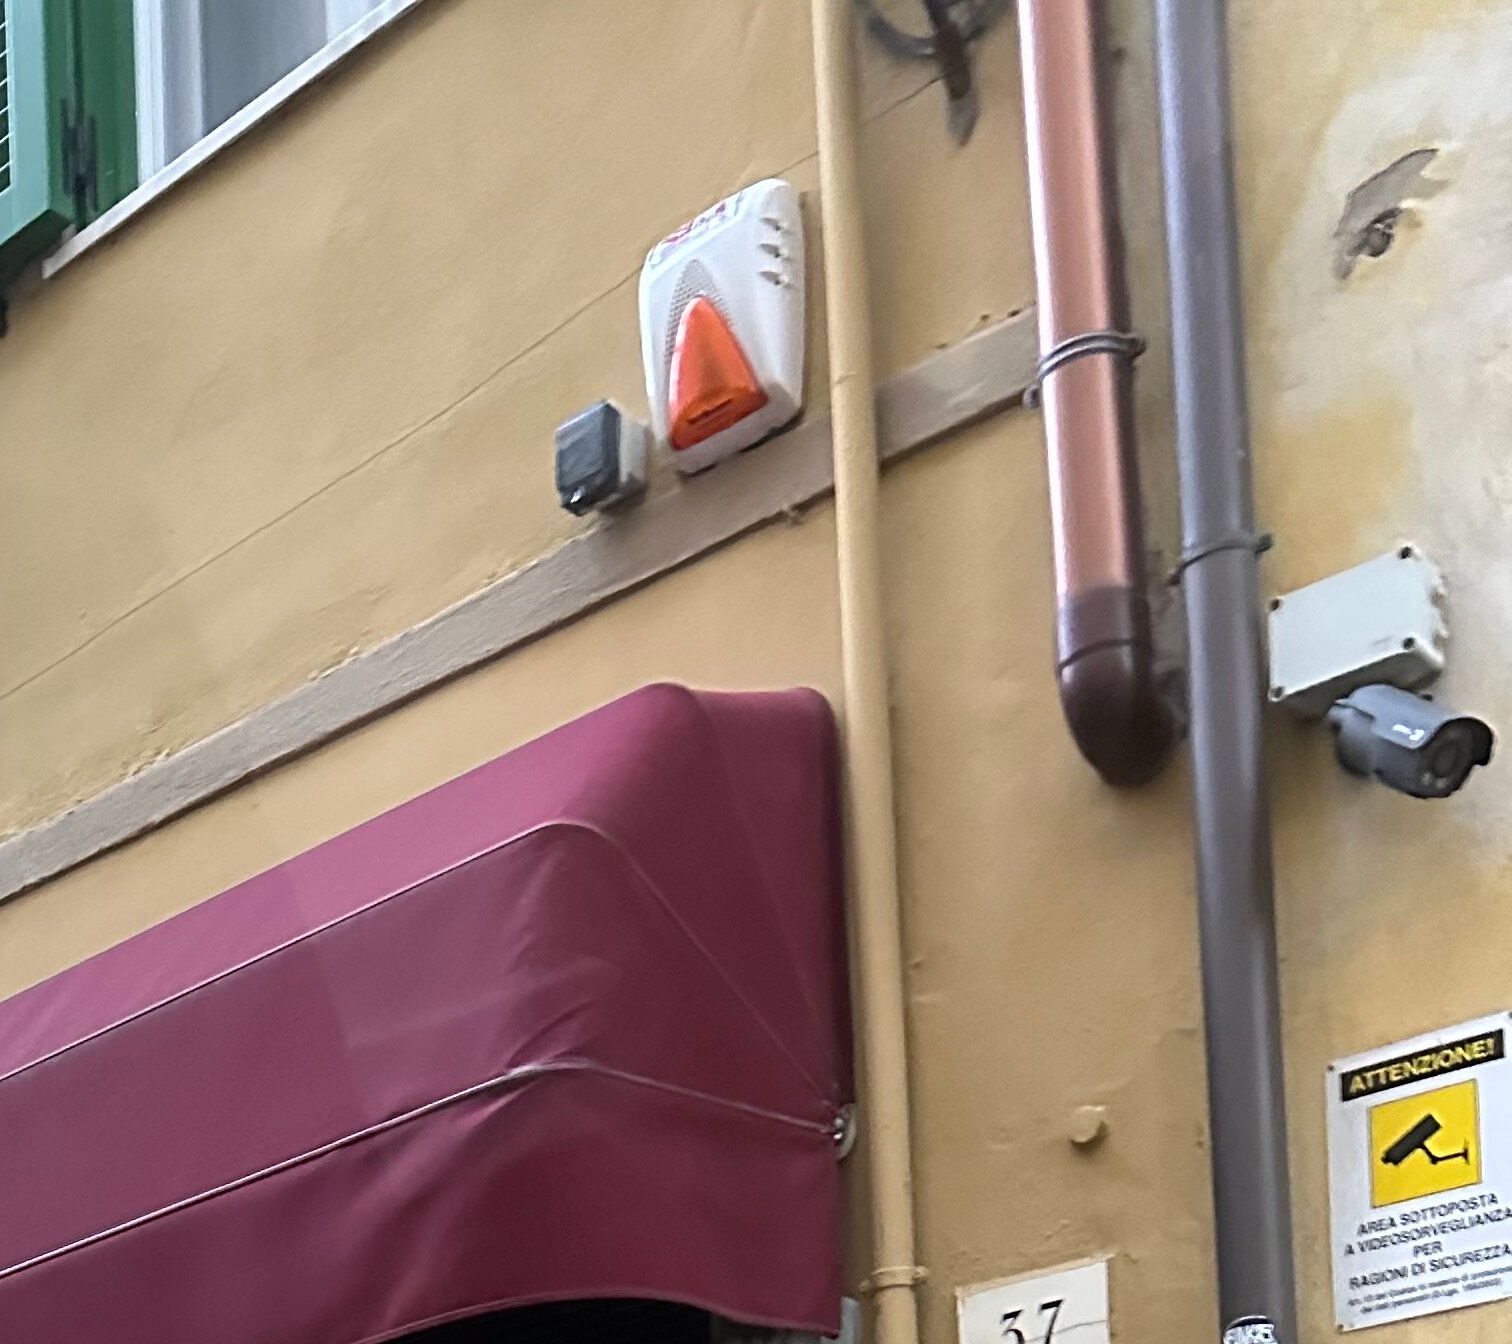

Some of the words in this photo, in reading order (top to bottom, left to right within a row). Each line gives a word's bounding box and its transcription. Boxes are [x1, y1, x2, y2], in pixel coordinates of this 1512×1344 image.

[1348, 1037, 1495, 1093] ATTENZIONE!
[1344, 1243, 1355, 1256] A
[1358, 1207, 1512, 1252] VIDEOSORVEGLIANZA
[1357, 1216, 1396, 1236] AREA
[1400, 1193, 1498, 1226] SOTTOPOSTA
[1349, 1265, 1408, 1290] RAGIONI
[1411, 1262, 1426, 1276] DI
[1429, 1243, 1512, 1272] SICUREZZA
[1413, 1240, 1443, 1257] PER
